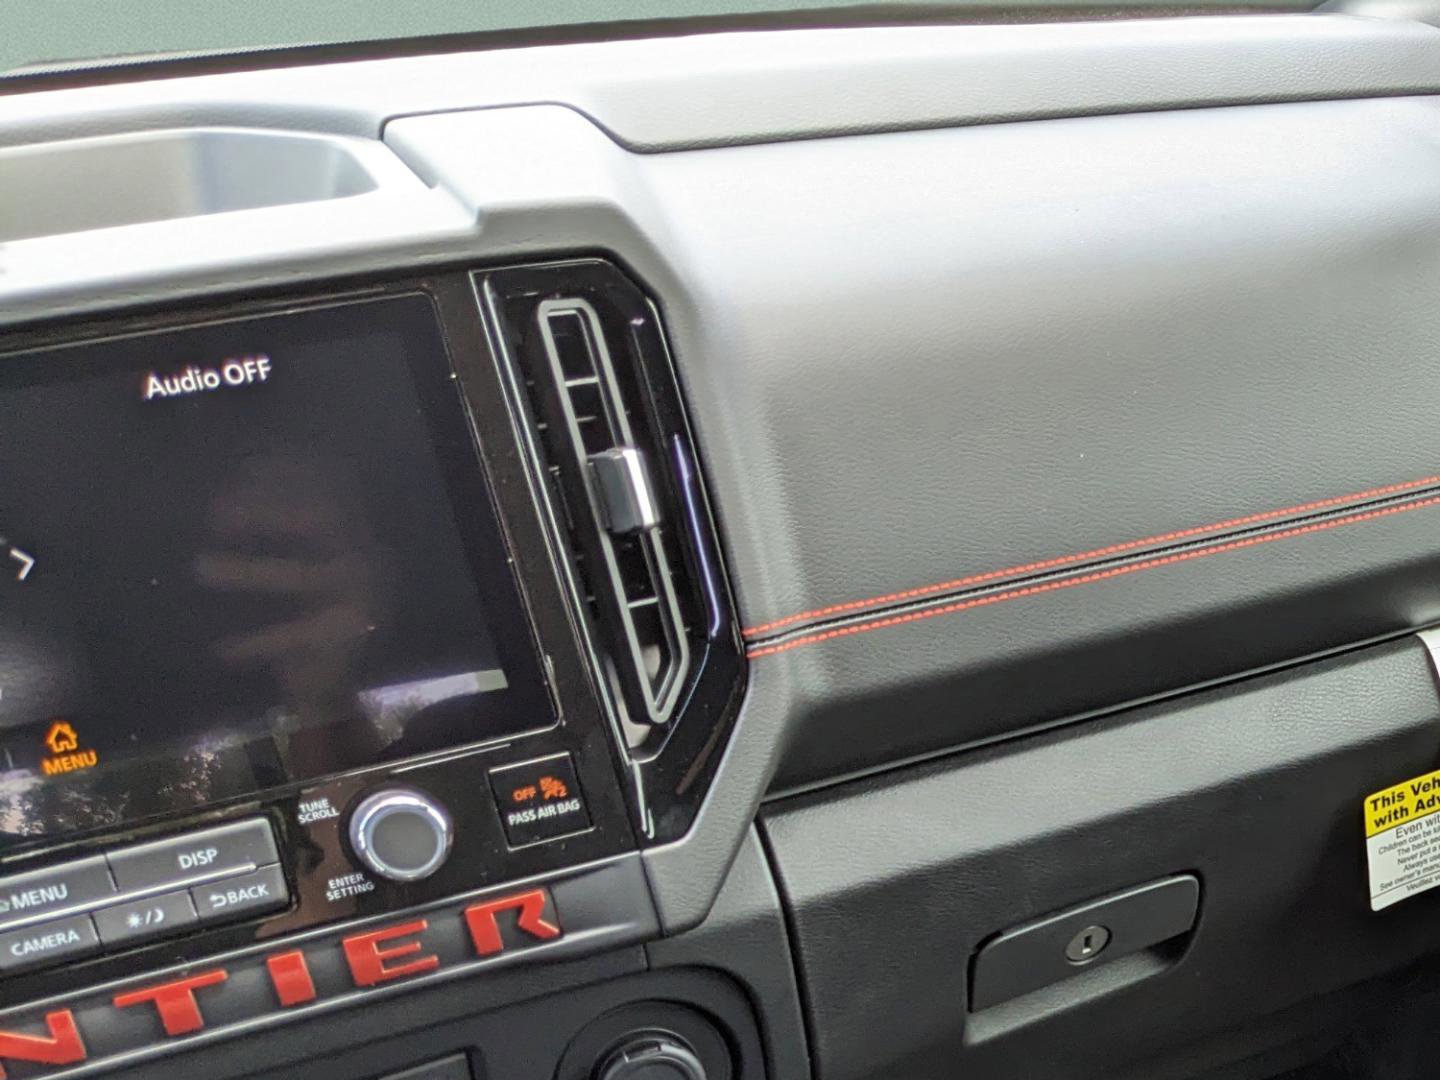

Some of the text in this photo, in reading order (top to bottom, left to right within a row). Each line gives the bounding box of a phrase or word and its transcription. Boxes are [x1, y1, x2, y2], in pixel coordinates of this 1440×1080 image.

[147, 357, 272, 400] Audio OFF
[41, 750, 98, 775] MENU
[512, 785, 536, 801] OFF
[1370, 792, 1405, 812] This
[299, 798, 329, 813] TUNE
[508, 798, 580, 825] PASS AIR BAG
[298, 808, 340, 824] SCROLL
[1373, 808, 1409, 828] with
[1395, 822, 1423, 839] Even
[1378, 839, 1407, 855] Children
[1408, 834, 1422, 843] can
[1422, 829, 1432, 838] be
[1397, 846, 1411, 856] The
[1411, 840, 1428, 851] back
[178, 848, 218, 870] DISP
[1397, 852, 1418, 865] Never
[1419, 847, 1431, 858] put
[1403, 858, 1428, 873] Always
[328, 872, 364, 889] ENTER
[1379, 881, 1393, 891] See
[1394, 869, 1421, 885] owner's
[10, 883, 68, 910] MENU
[227, 883, 269, 904] BACK
[326, 881, 375, 901] SETTING
[11, 929, 80, 956] CAMERA
[0, 889, 560, 1080] NTIER
